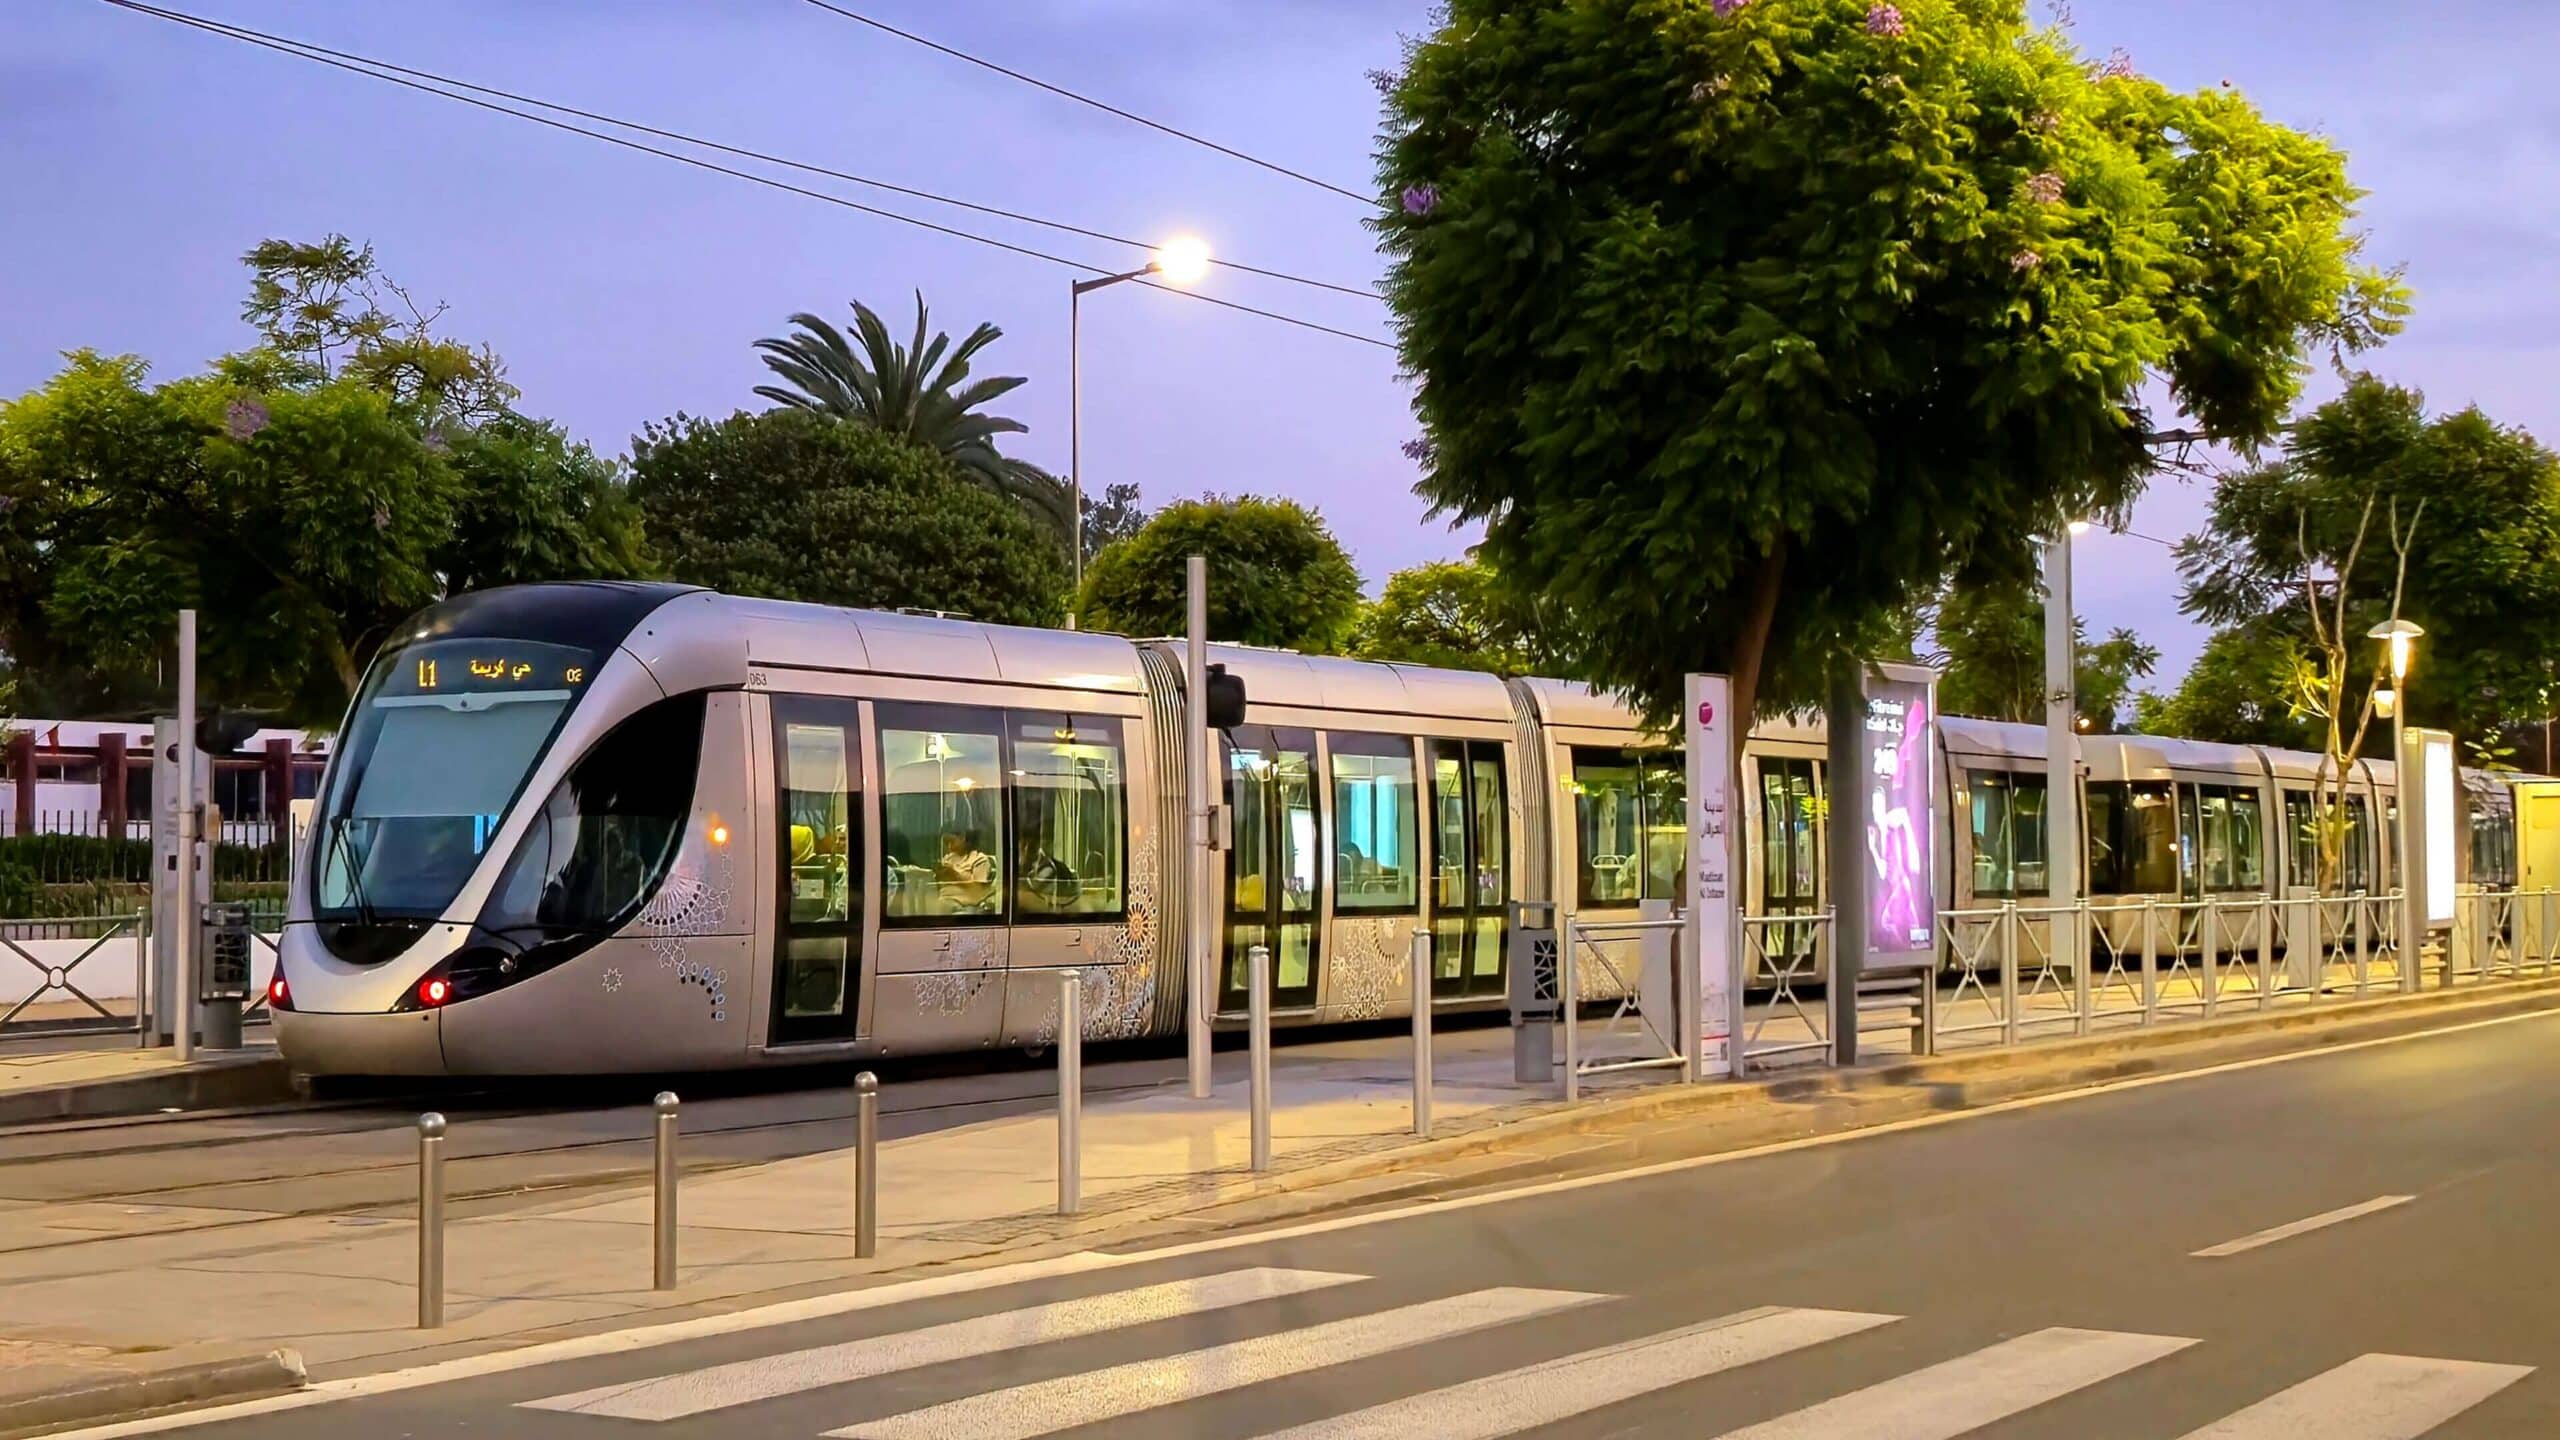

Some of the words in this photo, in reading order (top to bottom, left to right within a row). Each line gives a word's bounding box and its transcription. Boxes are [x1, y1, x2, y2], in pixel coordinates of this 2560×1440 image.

[418, 659, 437, 687] L1
[470, 658, 504, 679] كريمة
[512, 662, 532, 680] حي
